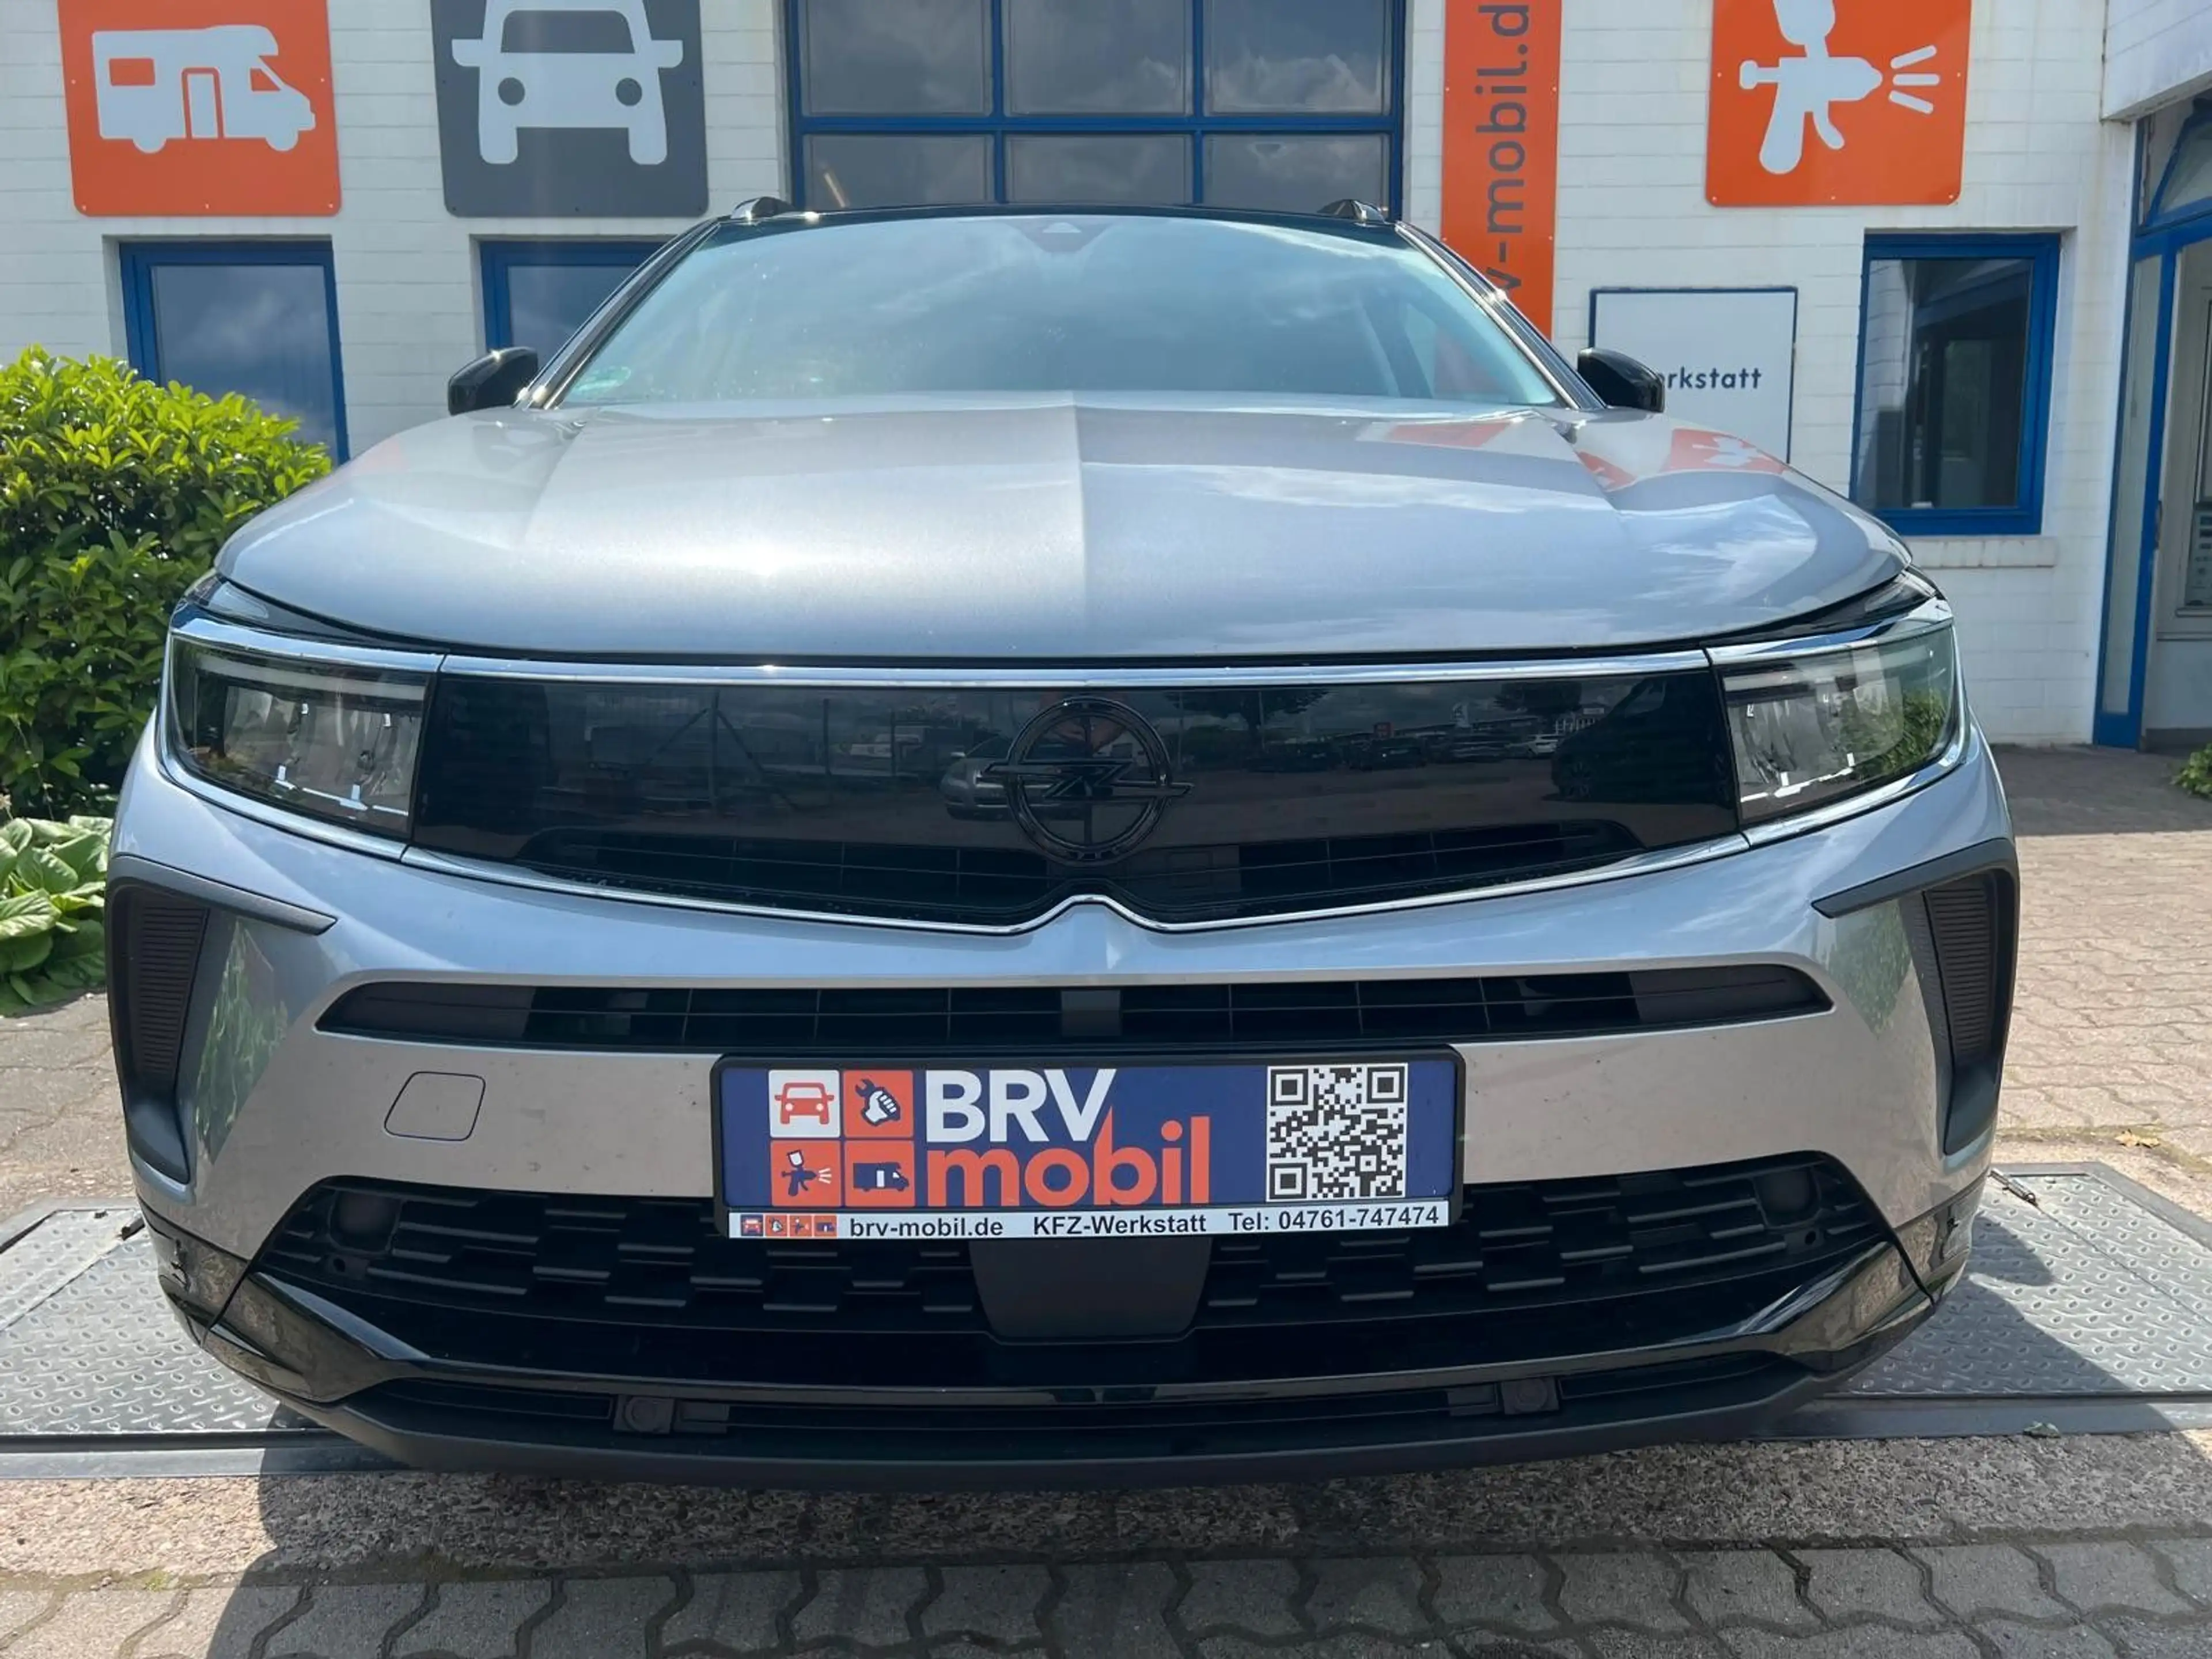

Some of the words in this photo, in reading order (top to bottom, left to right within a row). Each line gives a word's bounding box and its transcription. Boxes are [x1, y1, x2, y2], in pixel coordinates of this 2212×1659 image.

[1657, 365, 1762, 389] rkstatt
[925, 1069, 1116, 1142] BRV
[926, 1105, 1210, 1206] mobil
[850, 1217, 1003, 1237] brv-mobil.de
[1033, 1214, 1207, 1235] KFZ-Werkstatt
[1228, 1211, 1269, 1231] Tel:
[1279, 1206, 1440, 1229] 04761-747474
